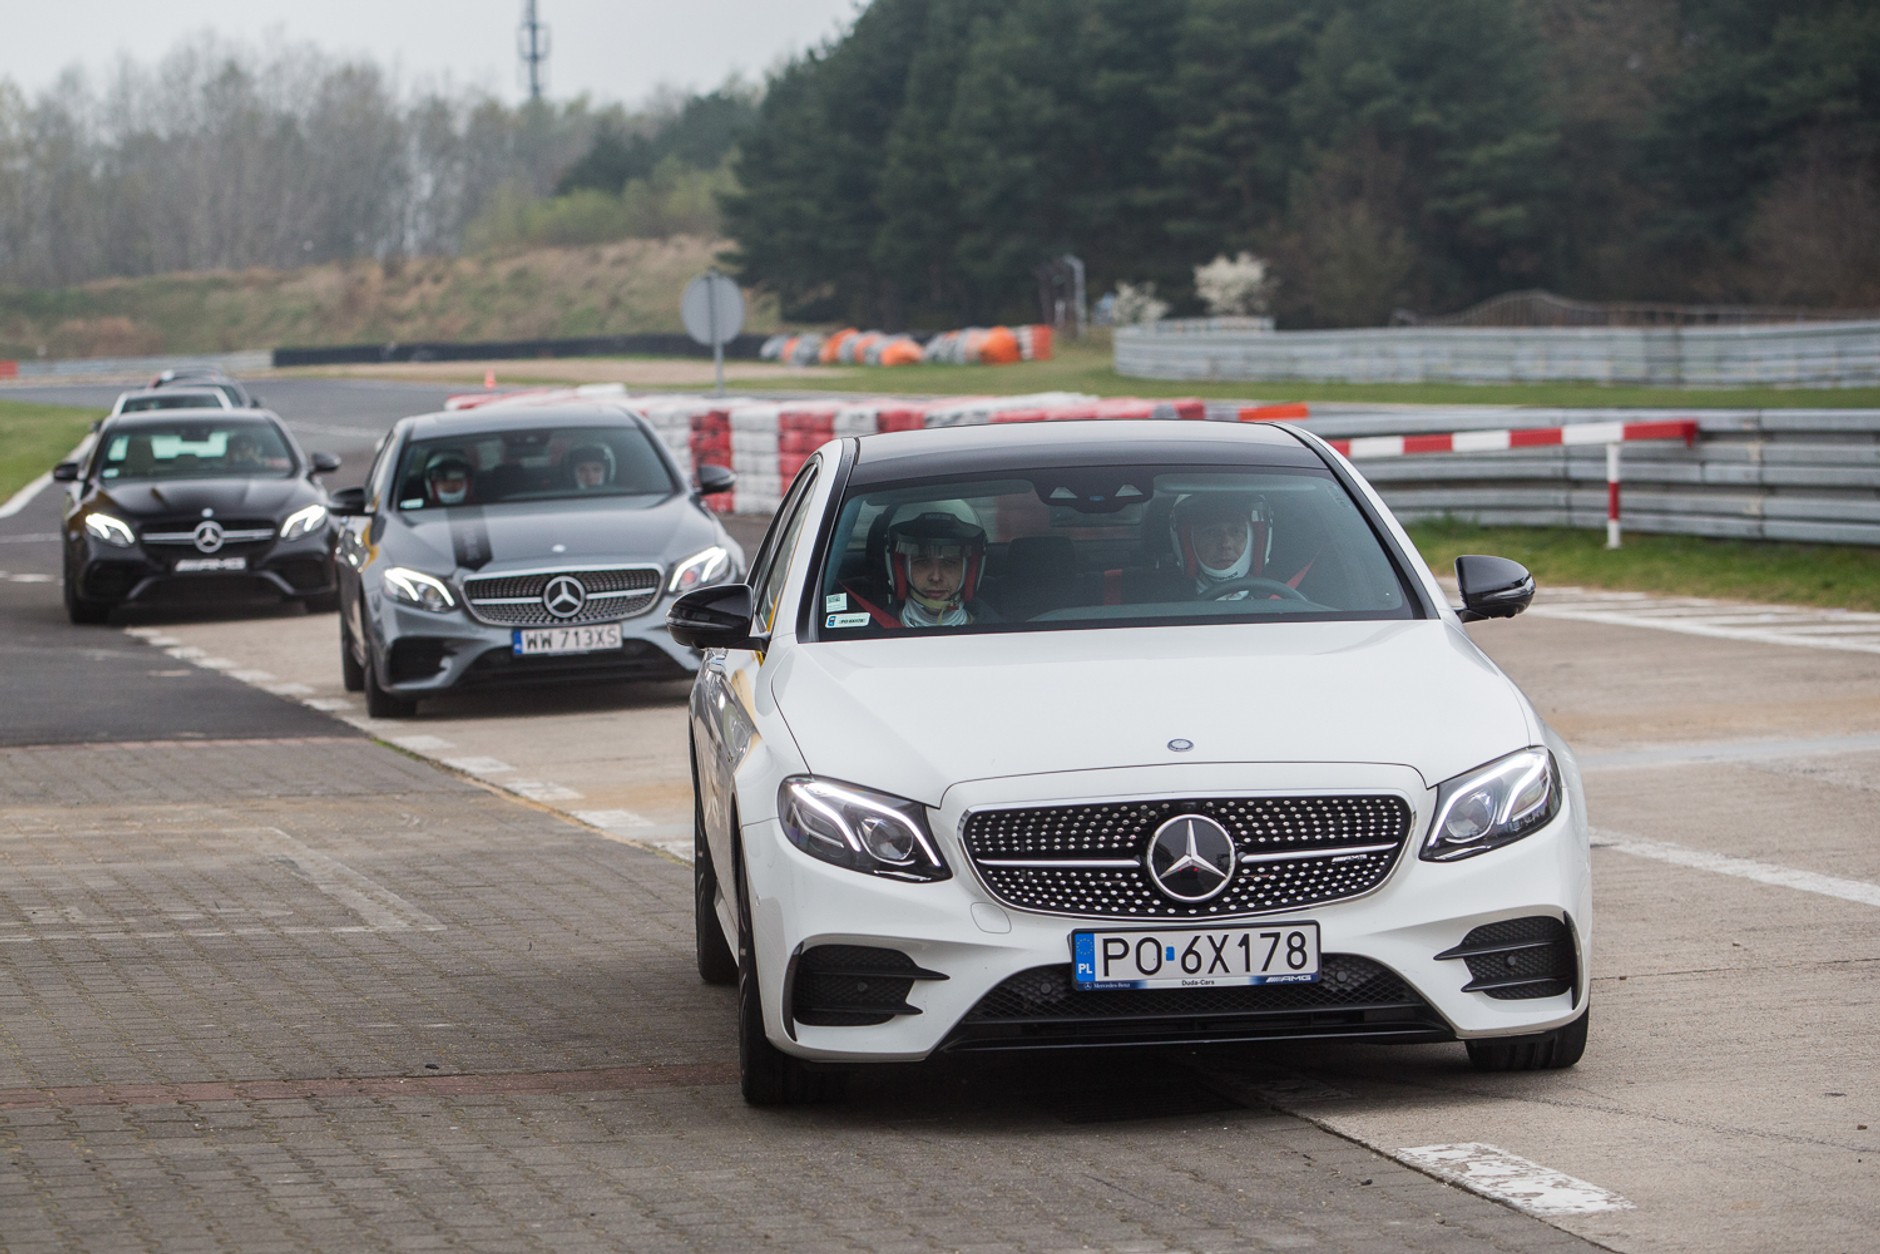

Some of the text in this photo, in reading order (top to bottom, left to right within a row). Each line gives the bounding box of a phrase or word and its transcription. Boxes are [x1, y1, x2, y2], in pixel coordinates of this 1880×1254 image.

[526, 632, 552, 650] WW
[560, 628, 617, 648] 713XS
[1102, 930, 1307, 977] PO 6X178
[1078, 963, 1093, 975] PL
[1181, 979, 1215, 987] Duda-Cars
[1279, 974, 1312, 982] AMG
